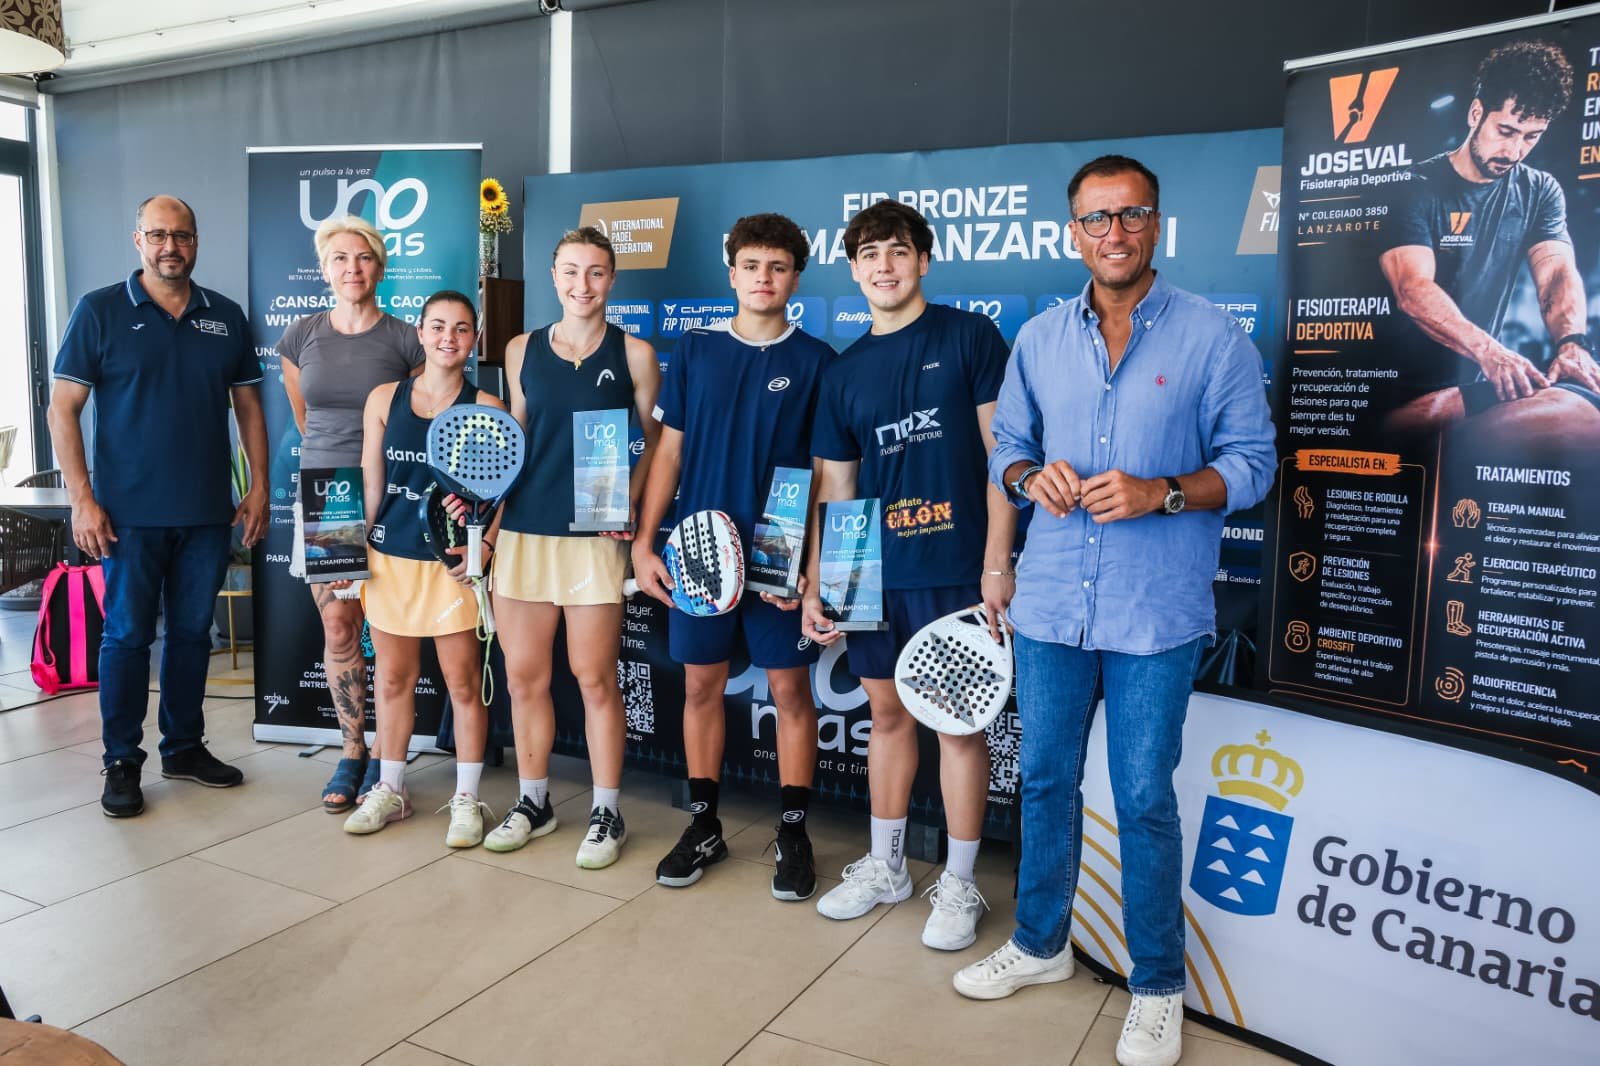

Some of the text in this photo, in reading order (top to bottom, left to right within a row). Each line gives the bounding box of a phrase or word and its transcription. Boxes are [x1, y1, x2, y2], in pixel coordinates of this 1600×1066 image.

[1301, 144, 1413, 176] JOSEVAL
[299, 168, 311, 176] un
[312, 167, 336, 178] pulso
[345, 168, 354, 176] la
[355, 168, 371, 176] vez
[1300, 170, 1412, 191] Fisioterapia Deportiva
[300, 177, 429, 231] uno
[1312, 209, 1362, 221] COLEGIADO
[1365, 206, 1388, 216] 3850
[611, 217, 664, 231] INTERNATIONAL
[1298, 220, 1380, 235] LANZAROTE
[384, 231, 425, 257] as
[611, 231, 632, 242] PADEL
[270, 295, 336, 311] ¿CANSAD
[606, 304, 650, 315] INTERNATIONAL
[680, 305, 734, 314] CUPRA
[1297, 297, 1391, 318] FISIOTERAPIA
[663, 317, 679, 331] FIP
[1296, 321, 1375, 341] DEPORTIVA
[1292, 367, 1398, 379] Prevención, tratamiento
[1291, 382, 1370, 396] y recuperación de
[1291, 396, 1368, 410] lesiones para que
[1290, 410, 1355, 424] siempre des tu
[584, 423, 616, 440] uno
[1290, 424, 1351, 438] mejor versión.
[386, 446, 427, 463] dana
[1309, 454, 1388, 470] ESPECIALISTA EN:
[1475, 465, 1571, 487] TRATAMIENTOS
[314, 480, 351, 497] uno
[770, 481, 799, 498] uno
[1327, 489, 1409, 504] LESIONES DE RODILLA
[326, 494, 351, 503] mas
[777, 498, 798, 508] mas
[1365, 504, 1404, 515] tratamiento
[1488, 502, 1567, 519] TERAPIA MANUAL
[831, 514, 867, 532] uno
[1330, 511, 1370, 524] readaptación
[1371, 516, 1386, 525] para
[1387, 518, 1400, 526] una
[842, 530, 867, 540] mas
[1324, 523, 1397, 536] recuperación completa
[1486, 523, 1517, 534] Técnicas
[1518, 527, 1556, 537] avanzadas
[1557, 530, 1574, 540] para
[1493, 535, 1511, 544] dolor
[1519, 538, 1552, 549] restaurar
[1562, 542, 1600, 553] movimien
[266, 554, 291, 563] PARA
[320, 557, 354, 566] CHAMPION
[1323, 555, 1370, 569] PREVENCIÓN
[760, 567, 787, 577] CHAMPION
[1322, 566, 1370, 581] DE LESIONES
[1483, 557, 1597, 580] EJERCICIO TERAPÉUTICO
[1357, 583, 1381, 595] trabajo
[1481, 574, 1597, 597] Programas personalizados para
[1320, 600, 1328, 608] de
[1358, 595, 1392, 607] corrección
[1517, 591, 1553, 602] estabilizar
[626, 602, 654, 618] layer.
[1478, 610, 1566, 632] HERRAMIENTAS DE
[1318, 626, 1403, 649] AMBIENTE DEPORTIVO
[1477, 623, 1586, 649] RECUPERACIÓN ACTIVA
[1317, 638, 1355, 653] CROSSFIT
[1524, 646, 1550, 658] masaje
[1316, 651, 1351, 665] Experiencia
[1369, 659, 1394, 671] trabajo
[1474, 651, 1498, 662] pistola
[1500, 653, 1509, 662] de
[1510, 656, 1546, 669] percusión
[1315, 661, 1374, 678] con atletas de alto
[1473, 674, 1557, 699] RADIOFRECUENCIA
[1471, 690, 1497, 703] Reduce
[1527, 700, 1554, 713] acelera
[1476, 703, 1500, 714] mejora
[1510, 708, 1537, 720] calidad
[1537, 713, 1549, 723] del
[753, 749, 777, 761] one
[819, 758, 833, 772] at
[837, 763, 845, 773] a
[1312, 836, 1576, 945] Gobierno
[1297, 885, 1357, 937] de
